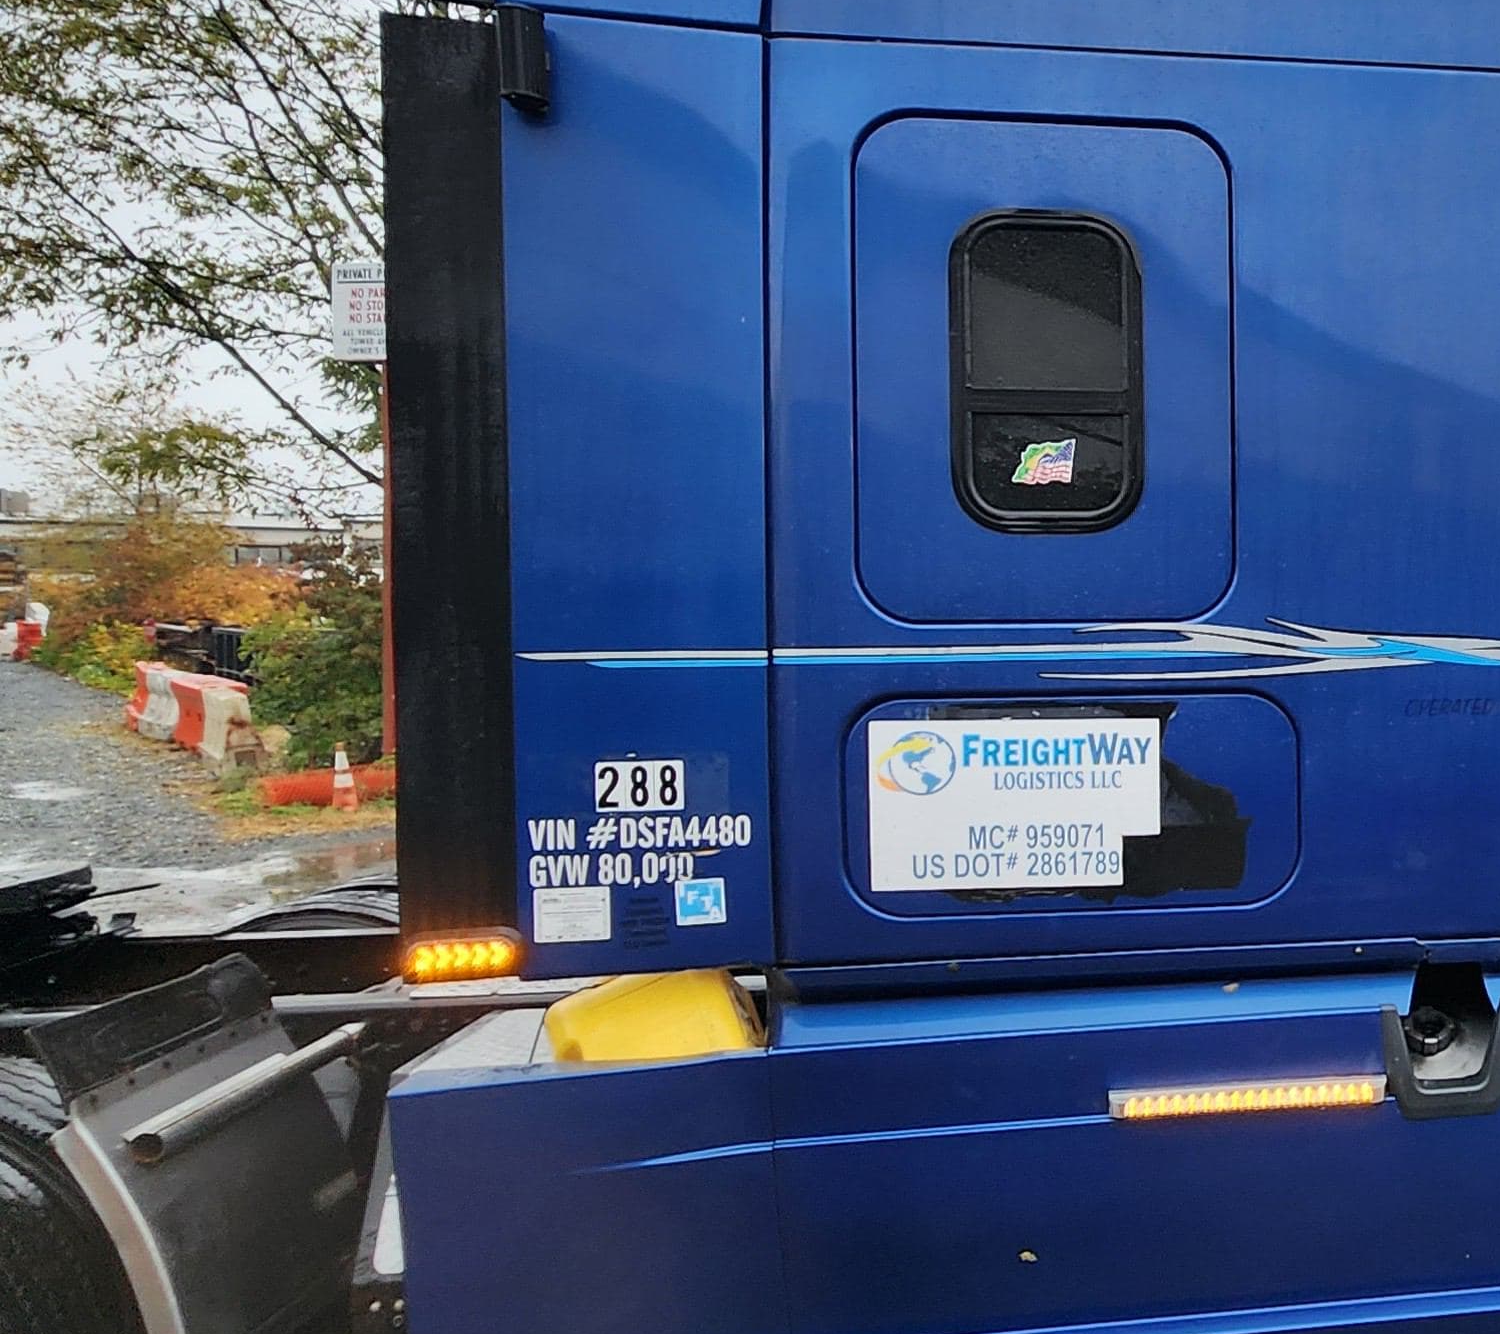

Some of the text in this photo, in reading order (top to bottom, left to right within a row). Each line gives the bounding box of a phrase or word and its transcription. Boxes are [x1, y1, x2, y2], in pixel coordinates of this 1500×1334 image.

[337, 269, 372, 279] PRIVATE
[352, 288, 364, 298] NO
[349, 300, 362, 311] NO
[349, 313, 362, 323] NO
[597, 765, 678, 808] 288
[993, 770, 1122, 791] LOGISTICS LLC
[527, 818, 576, 851] VIN
[968, 823, 1105, 851] MC# 959071
[529, 853, 590, 888] GVW
[912, 850, 1121, 879] US DOT# 2861789
